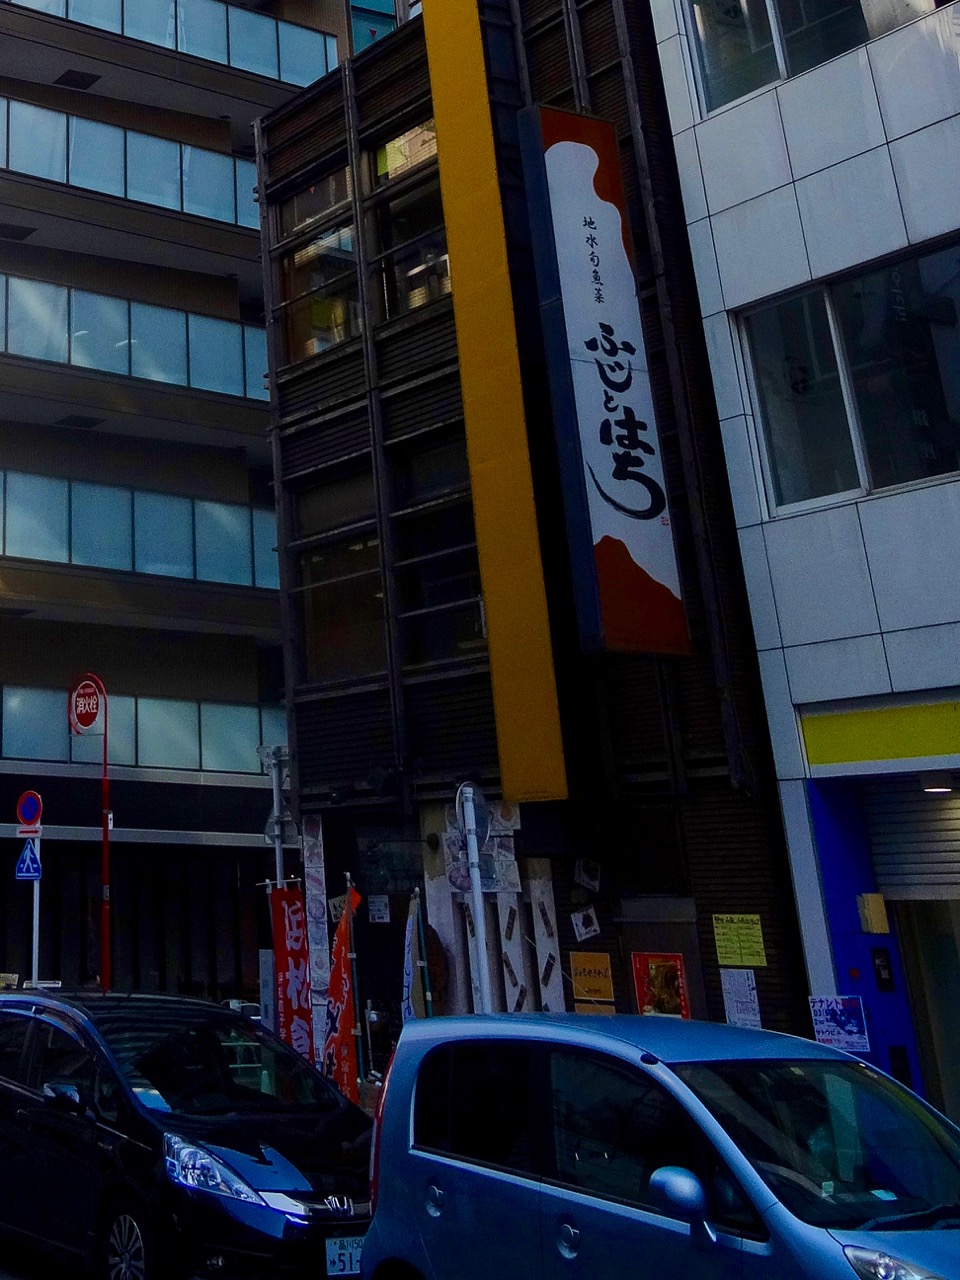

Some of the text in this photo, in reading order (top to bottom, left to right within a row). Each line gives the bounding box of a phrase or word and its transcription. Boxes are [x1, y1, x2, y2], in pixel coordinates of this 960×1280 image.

[584, 322, 667, 521] ふじとはち
[76, 695, 98, 714] 消火栓
[338, 1252, 361, 1272] 51-
